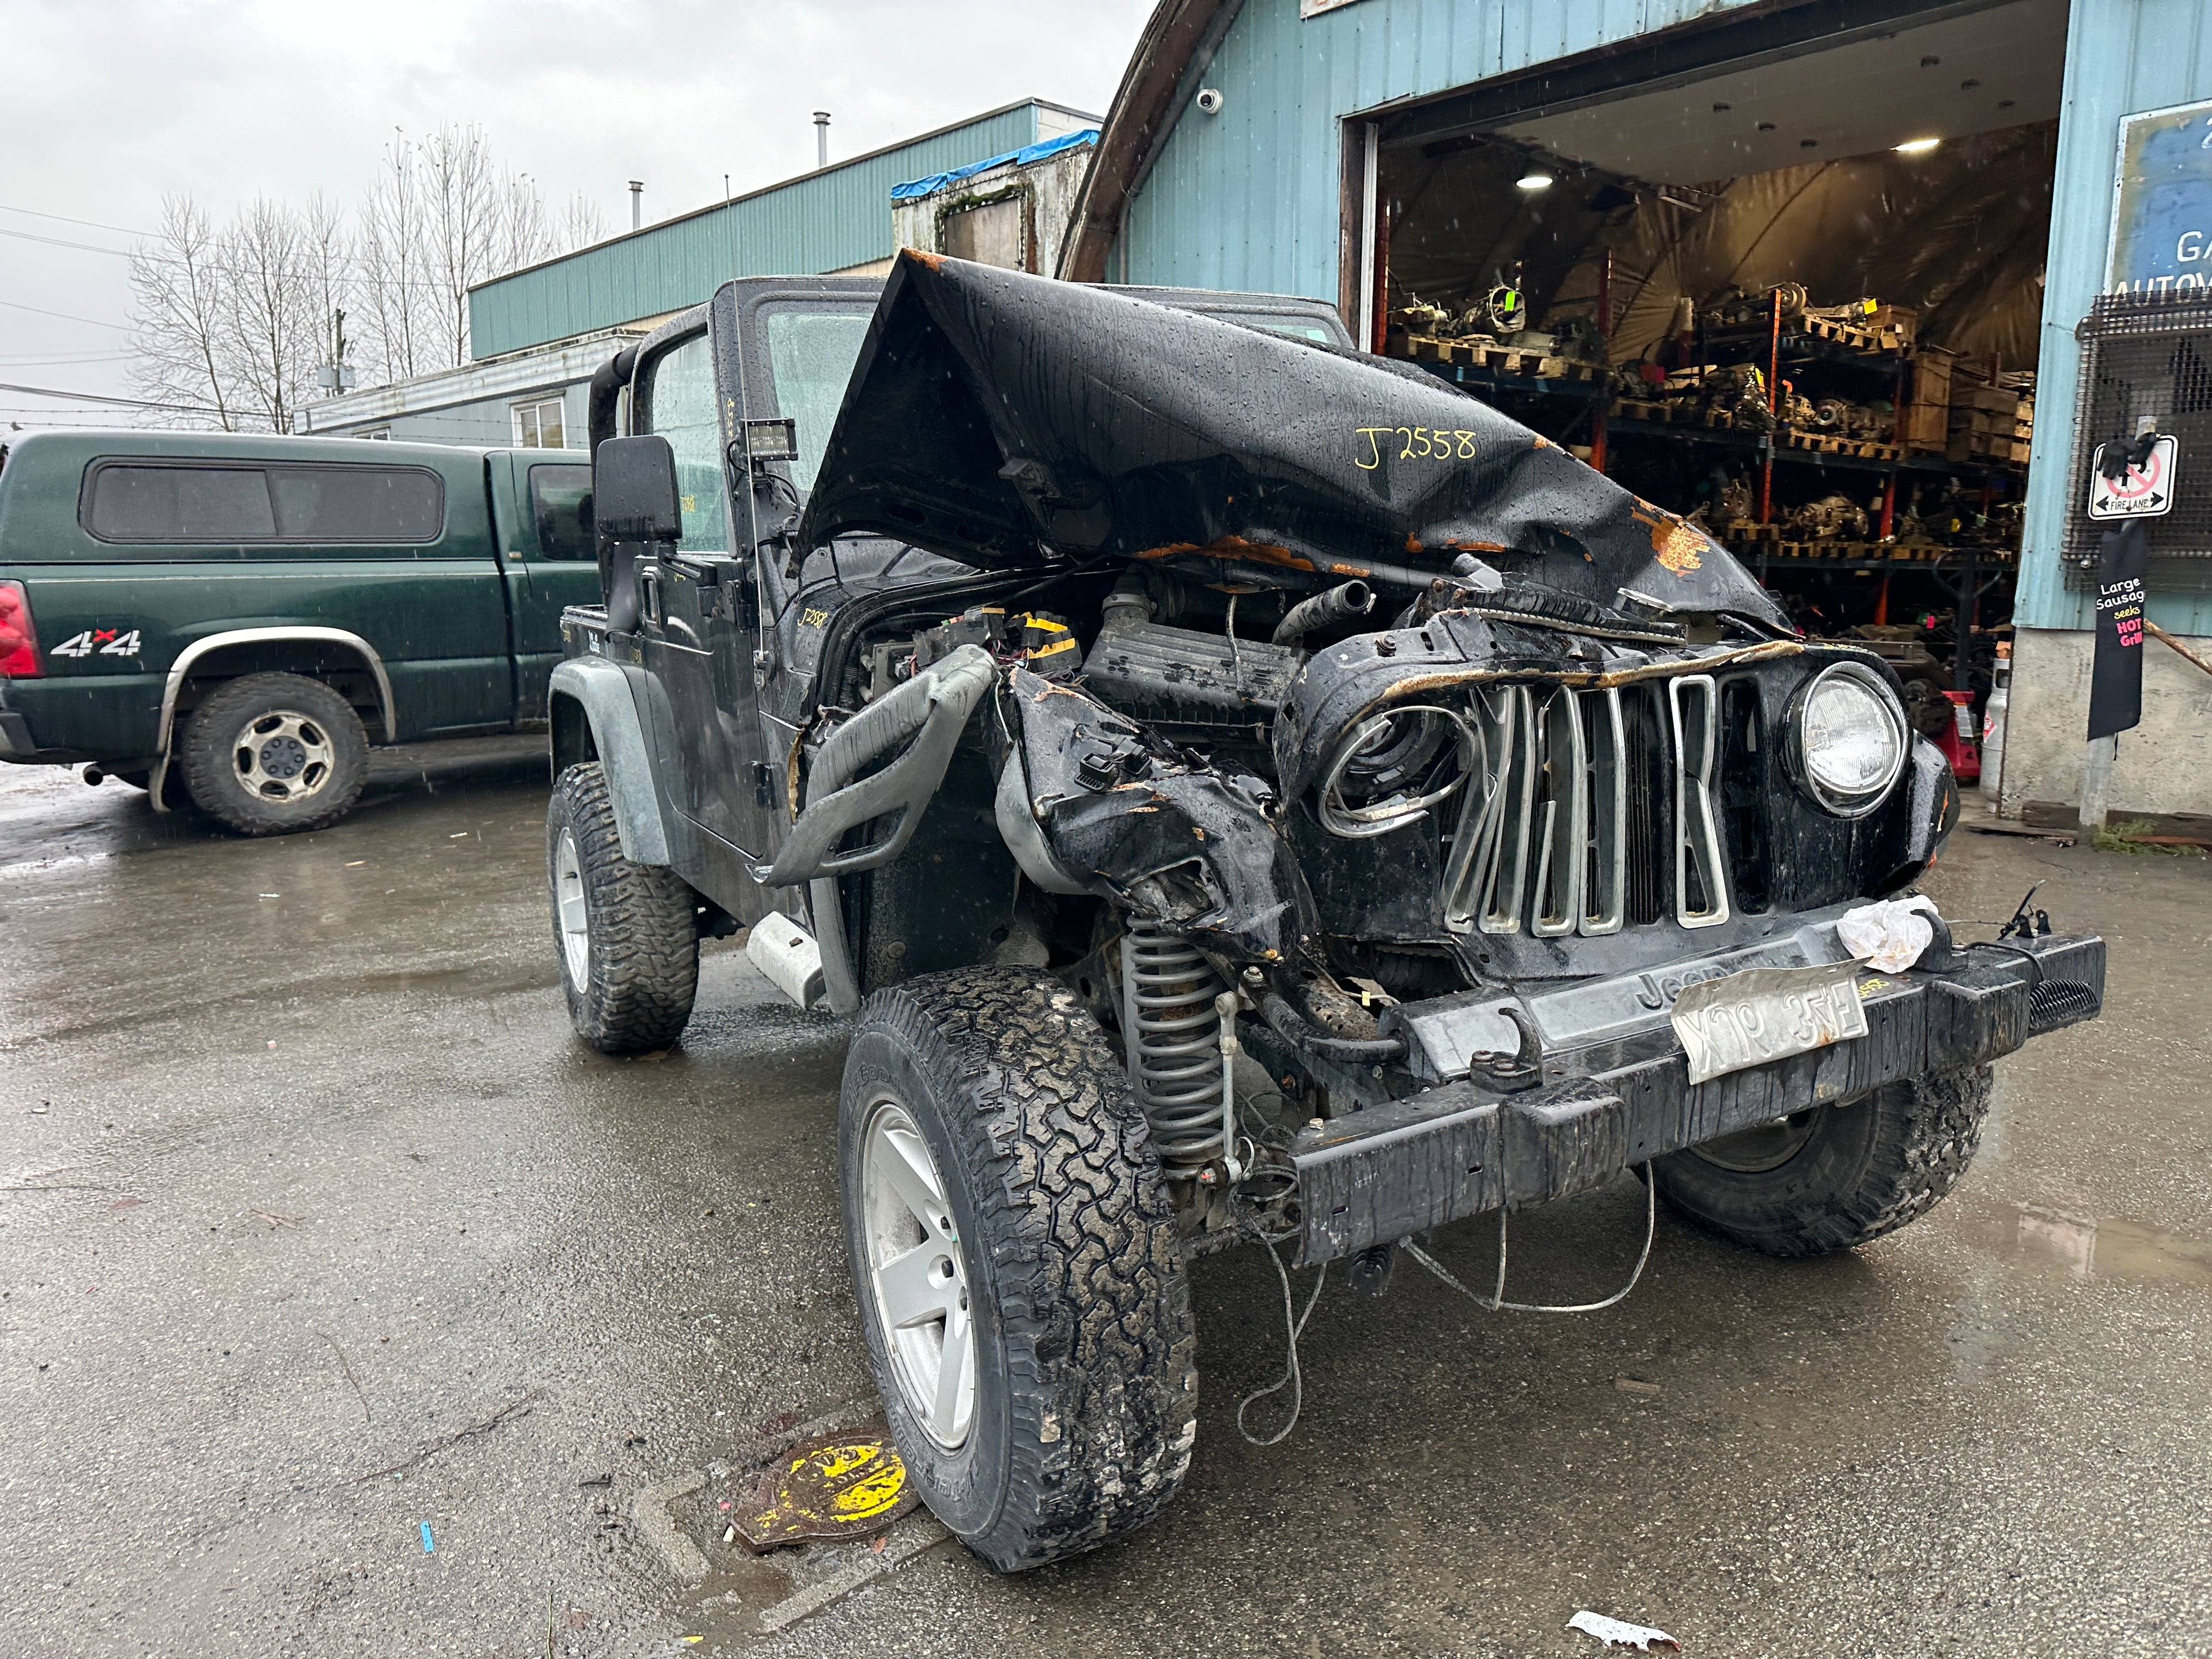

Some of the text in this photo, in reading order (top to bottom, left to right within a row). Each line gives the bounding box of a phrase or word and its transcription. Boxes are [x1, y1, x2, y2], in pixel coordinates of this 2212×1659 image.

[1354, 427, 1477, 469] J2558
[2110, 500, 2127, 511] FIRE
[2101, 578, 2141, 596] Large
[2096, 591, 2145, 610] Sausag
[797, 608, 828, 629] J2558
[2114, 605, 2141, 619] seeks
[2116, 618, 2142, 634] HOT
